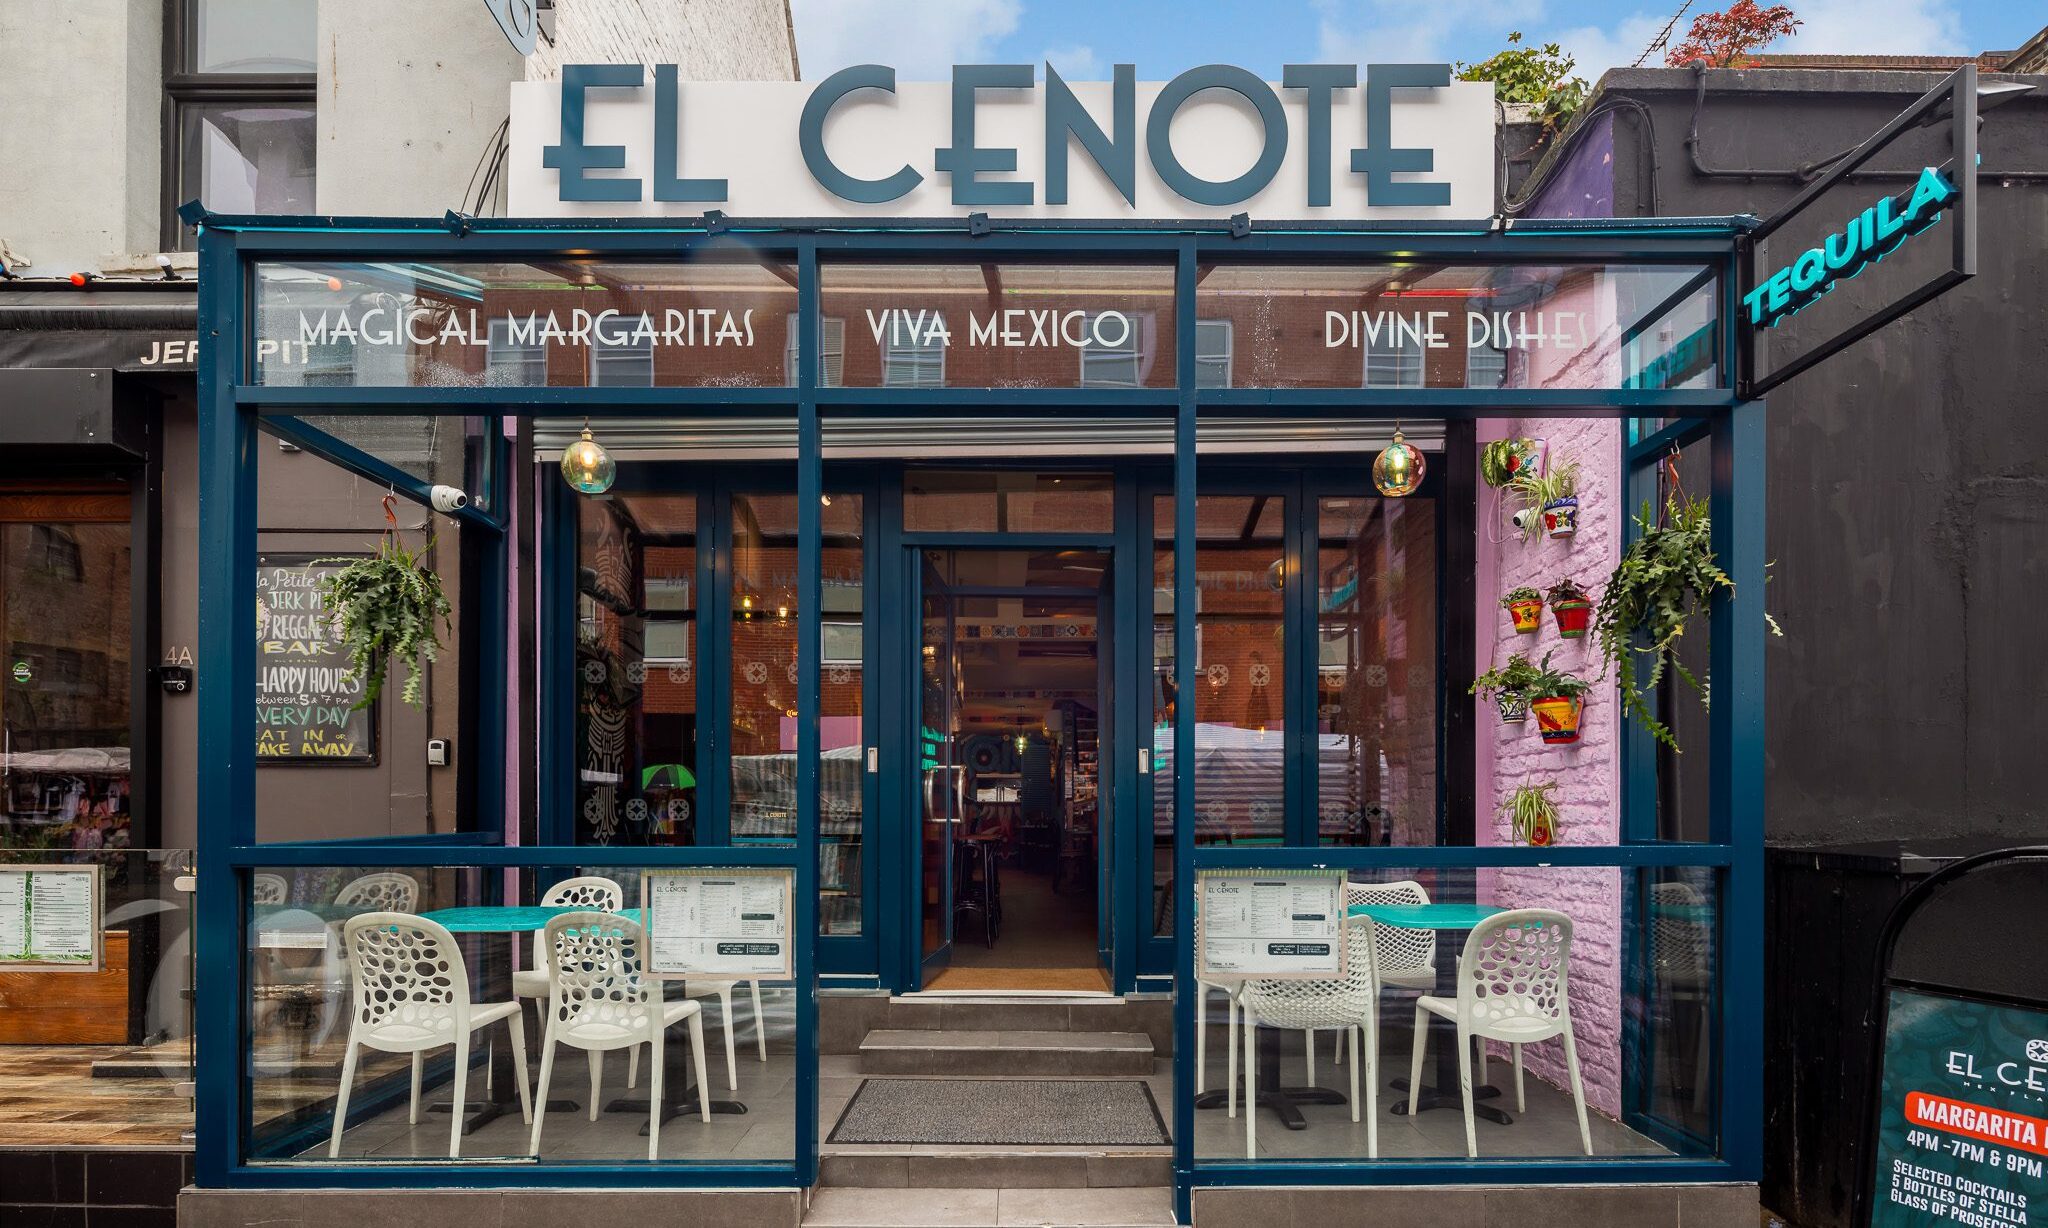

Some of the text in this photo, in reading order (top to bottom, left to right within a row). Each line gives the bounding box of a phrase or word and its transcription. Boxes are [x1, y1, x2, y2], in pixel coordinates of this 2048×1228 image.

[543, 60, 1451, 210] EL CENOTE
[1743, 166, 1957, 327] TEQUILA
[299, 309, 754, 346] MAGICAL MARGARITAS
[866, 309, 1130, 347] VIVA MEXICO
[1325, 311, 1589, 349] DIVINE DISHES
[257, 340, 308, 364] PIT
[268, 591, 305, 610] JERK
[272, 614, 325, 640] REGGAE
[165, 646, 193, 665] 4A
[264, 640, 336, 656] BAR
[256, 666, 306, 694] HAPPY
[256, 694, 299, 704] etween
[300, 693, 310, 706] 5
[256, 706, 351, 729] VERY DAY
[256, 729, 289, 741] AT
[303, 729, 324, 742] IN
[256, 742, 354, 757] AKE AWAY
[1945, 1051, 1983, 1079] EL
[1917, 1098, 2037, 1147] MARGARITA
[1906, 1129, 1939, 1152] 4PM
[1989, 1149, 2001, 1167] &
[2006, 1154, 2042, 1178] 9PM
[1893, 1159, 2027, 1209] SELECTED COCKTAILS
[1890, 1188, 2017, 1228] GLASS OF PROSEC
[1892, 1174, 2028, 1226] 5 BOTTLES OF STELLA
